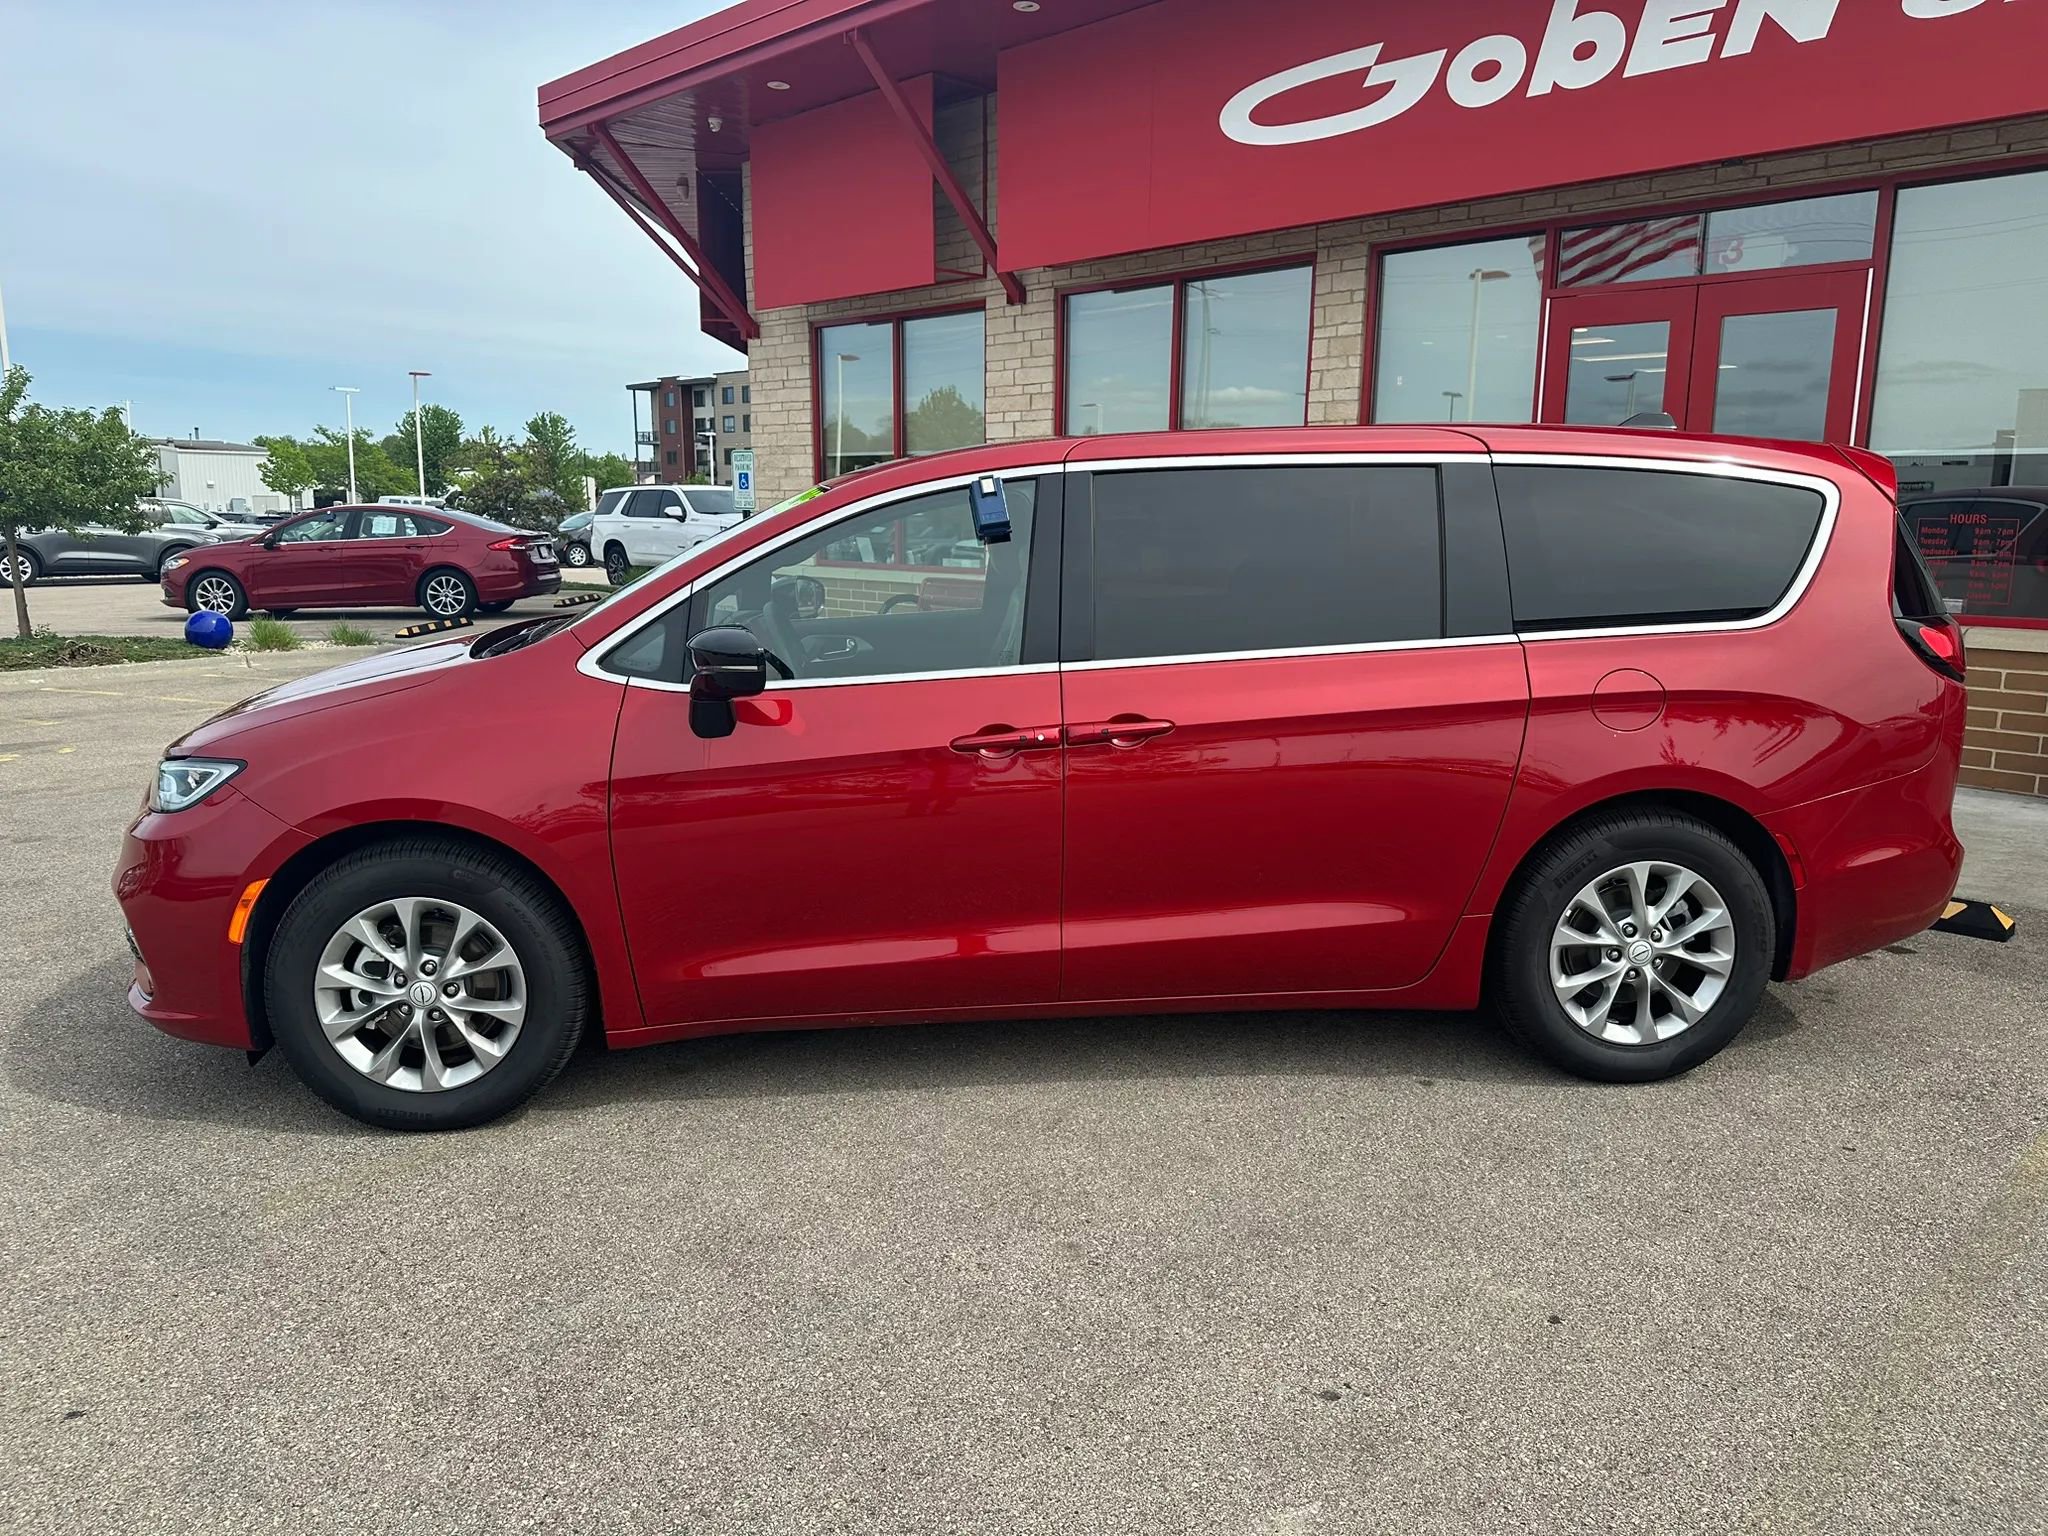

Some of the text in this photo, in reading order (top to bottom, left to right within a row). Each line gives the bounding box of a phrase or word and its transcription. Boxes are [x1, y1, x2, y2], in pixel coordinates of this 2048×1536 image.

[1950, 514, 1988, 524] HOURS
[1921, 527, 1948, 535] Monday
[1921, 538, 1947, 546] Tuesday
